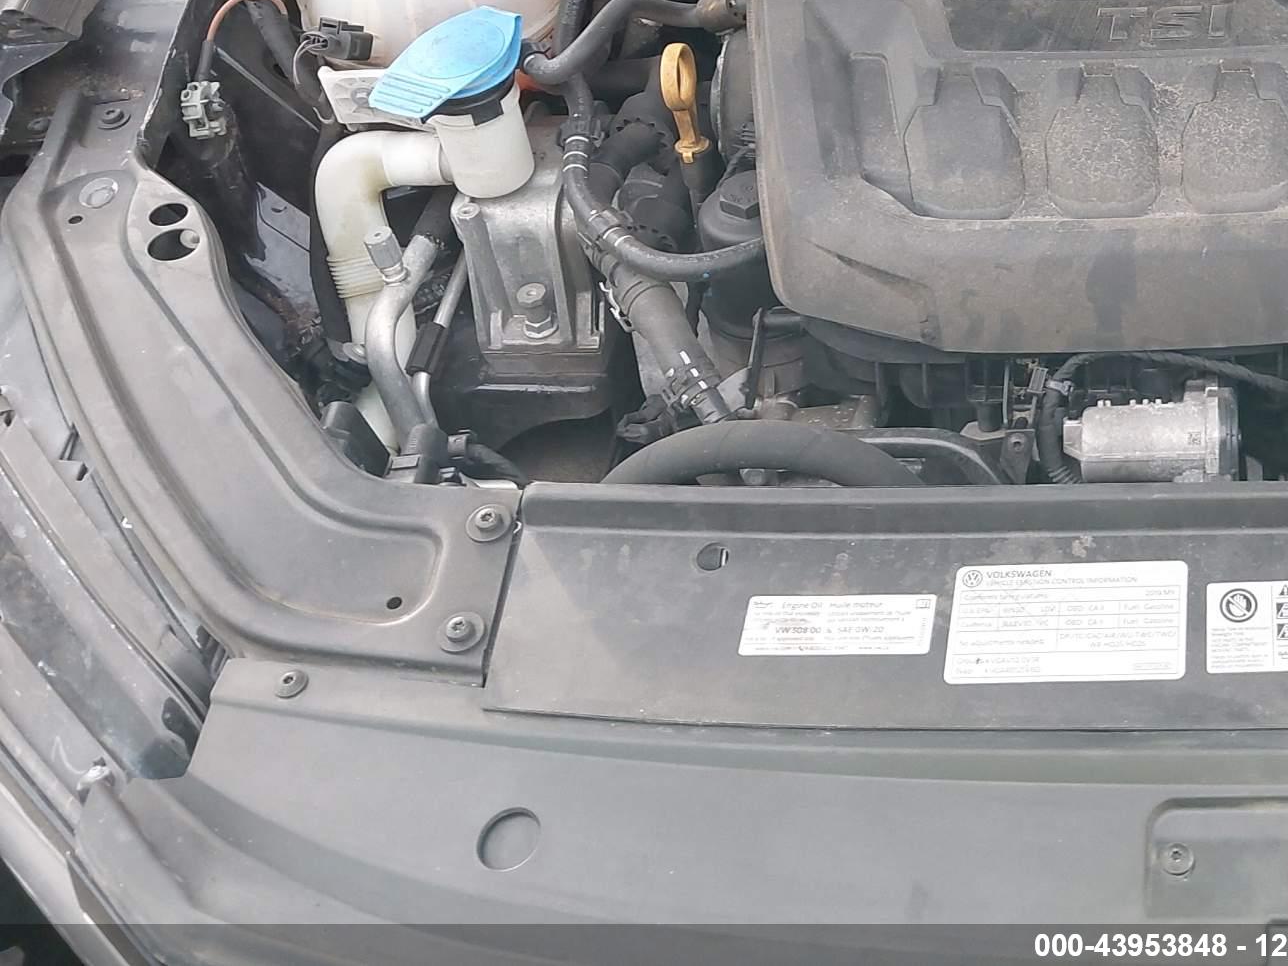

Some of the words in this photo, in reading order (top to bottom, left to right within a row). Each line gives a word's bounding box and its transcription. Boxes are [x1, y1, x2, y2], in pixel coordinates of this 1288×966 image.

[1096, 2, 1232, 43] TSI
[986, 569, 1053, 579] VOLKSWAGEN
[1086, 576, 1138, 584] INFORMATION
[782, 601, 809, 611] Engine
[811, 601, 823, 609] Oil
[775, 626, 791, 634] VW
